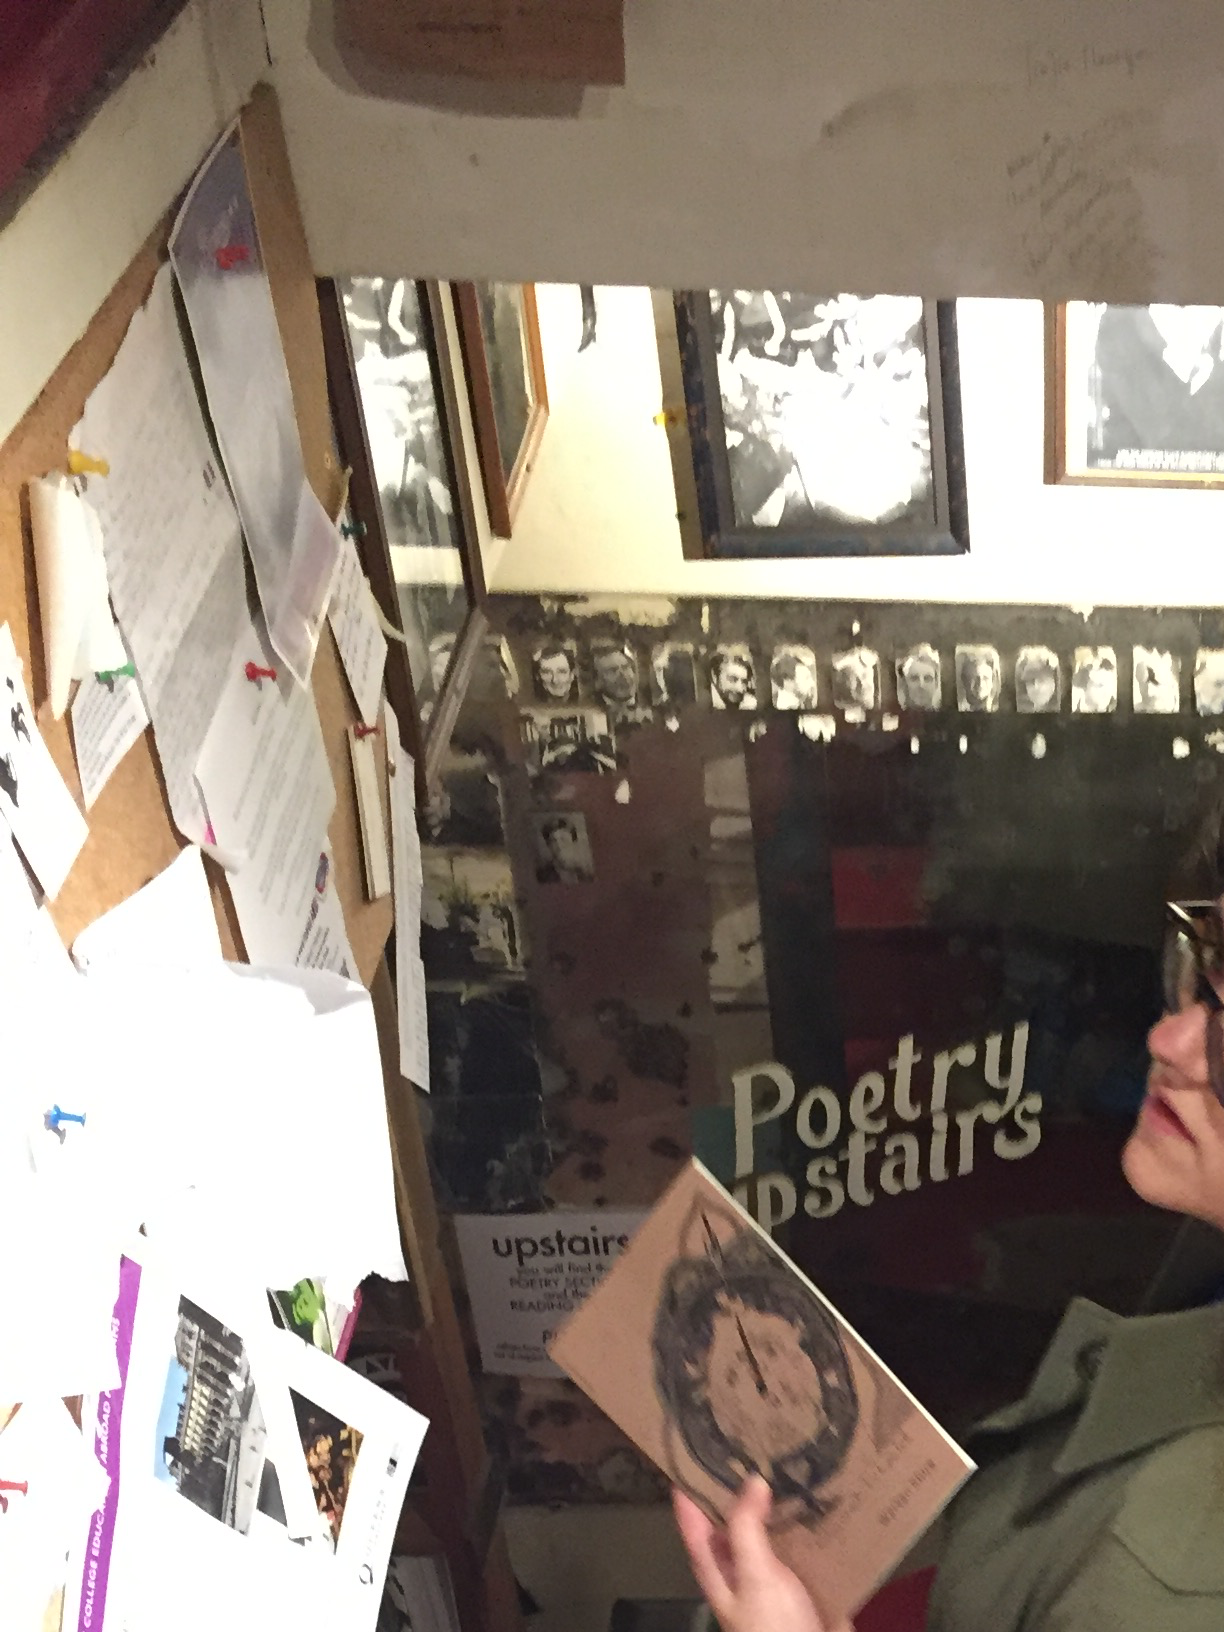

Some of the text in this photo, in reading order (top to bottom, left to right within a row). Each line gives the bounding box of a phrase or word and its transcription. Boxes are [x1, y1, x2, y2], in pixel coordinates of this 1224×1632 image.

[731, 1020, 1029, 1176] Poetry
[543, 1263, 564, 1274] will
[567, 1262, 591, 1274] find
[509, 1277, 559, 1289] POETRY
[510, 1300, 574, 1312] READING
[83, 1559, 98, 1628] COLLEGE
